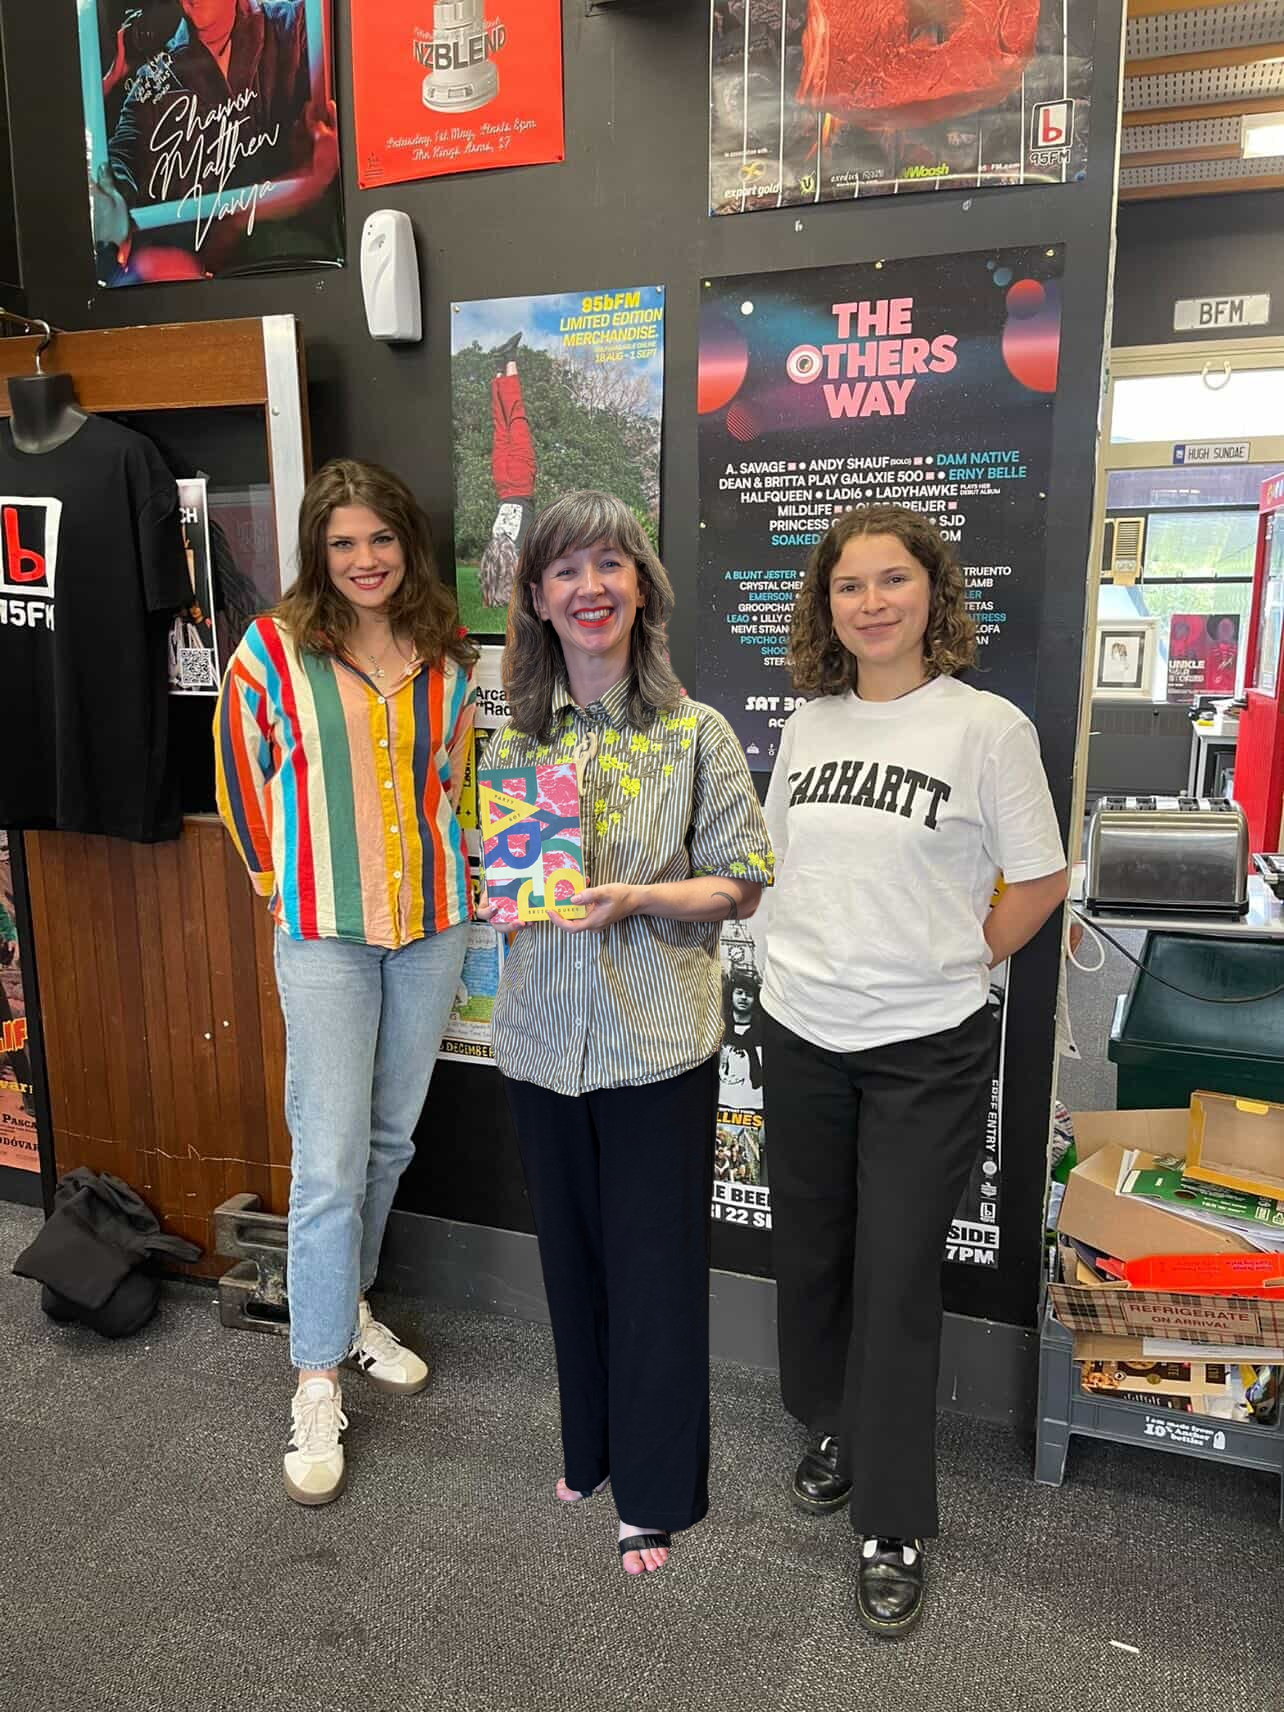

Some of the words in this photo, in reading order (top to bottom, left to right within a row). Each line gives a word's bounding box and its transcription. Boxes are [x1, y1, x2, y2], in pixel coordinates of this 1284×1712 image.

[413, 24, 506, 71] NZBLEND
[151, 88, 257, 151] Shannon
[150, 117, 279, 200] Matthew
[1030, 150, 1070, 166] 95FM
[724, 185, 756, 199] export
[758, 183, 780, 197] gold
[177, 165, 273, 251] Vanya
[560, 314, 610, 331] LIMITED
[612, 307, 663, 326] EDITION
[832, 298, 913, 339] THE
[1199, 299, 1244, 325] BFM
[564, 325, 657, 347] MERCHANDISE
[823, 378, 917, 419] WAY
[1188, 447, 1209, 459] HUGH
[1213, 446, 1246, 458] SUNDAE
[725, 463, 738, 475] A.
[739, 461, 787, 474] SAVAGE
[808, 459, 845, 471] ANDY
[847, 456, 890, 470] SHAUF
[936, 453, 967, 466] DAM
[970, 451, 1020, 464] NATIVE
[719, 477, 752, 490] DEAN
[753, 477, 763, 489] &
[764, 475, 806, 488] BRITTA
[808, 473, 838, 486] PLAY
[840, 471, 895, 485] GALAXIE
[897, 470, 923, 483] 500
[949, 467, 984, 481] ERNY
[987, 466, 1027, 479] BELLE
[741, 490, 812, 503] HALFQUEEN
[876, 484, 958, 498] LADYHAWKE
[778, 504, 832, 517] MILDLIFE
[769, 518, 829, 531] PRINCESS
[939, 515, 966, 527] SJD
[771, 533, 821, 546] SOAKED
[725, 571, 732, 580] A
[733, 571, 763, 579] BLUNT
[764, 570, 797, 579] JESTER
[740, 582, 779, 590] CRYSTAL
[965, 578, 994, 587] LAMB
[749, 593, 793, 601] EMERSON
[738, 603, 795, 612] GROOPCHAT
[760, 614, 782, 622] LILLY
[731, 625, 758, 634] NEIVE
[740, 636, 777, 644] PSYCHO
[745, 696, 779, 711] SAT
[494, 794, 514, 805] PARTY
[509, 813, 522, 822] BOY
[985, 1111, 998, 1153] ENTRY
[726, 1206, 749, 1225] 22
[948, 1226, 996, 1245] SIDE
[946, 1245, 995, 1264] 7PM
[1129, 1304, 1249, 1321] REFRIGERATE
[1175, 1317, 1230, 1329] ARRIVAL
[1166, 1421, 1189, 1430] made
[1191, 1425, 1214, 1435] from
[1175, 1428, 1211, 1441] Anchor
[1171, 1433, 1204, 1446] bottles
